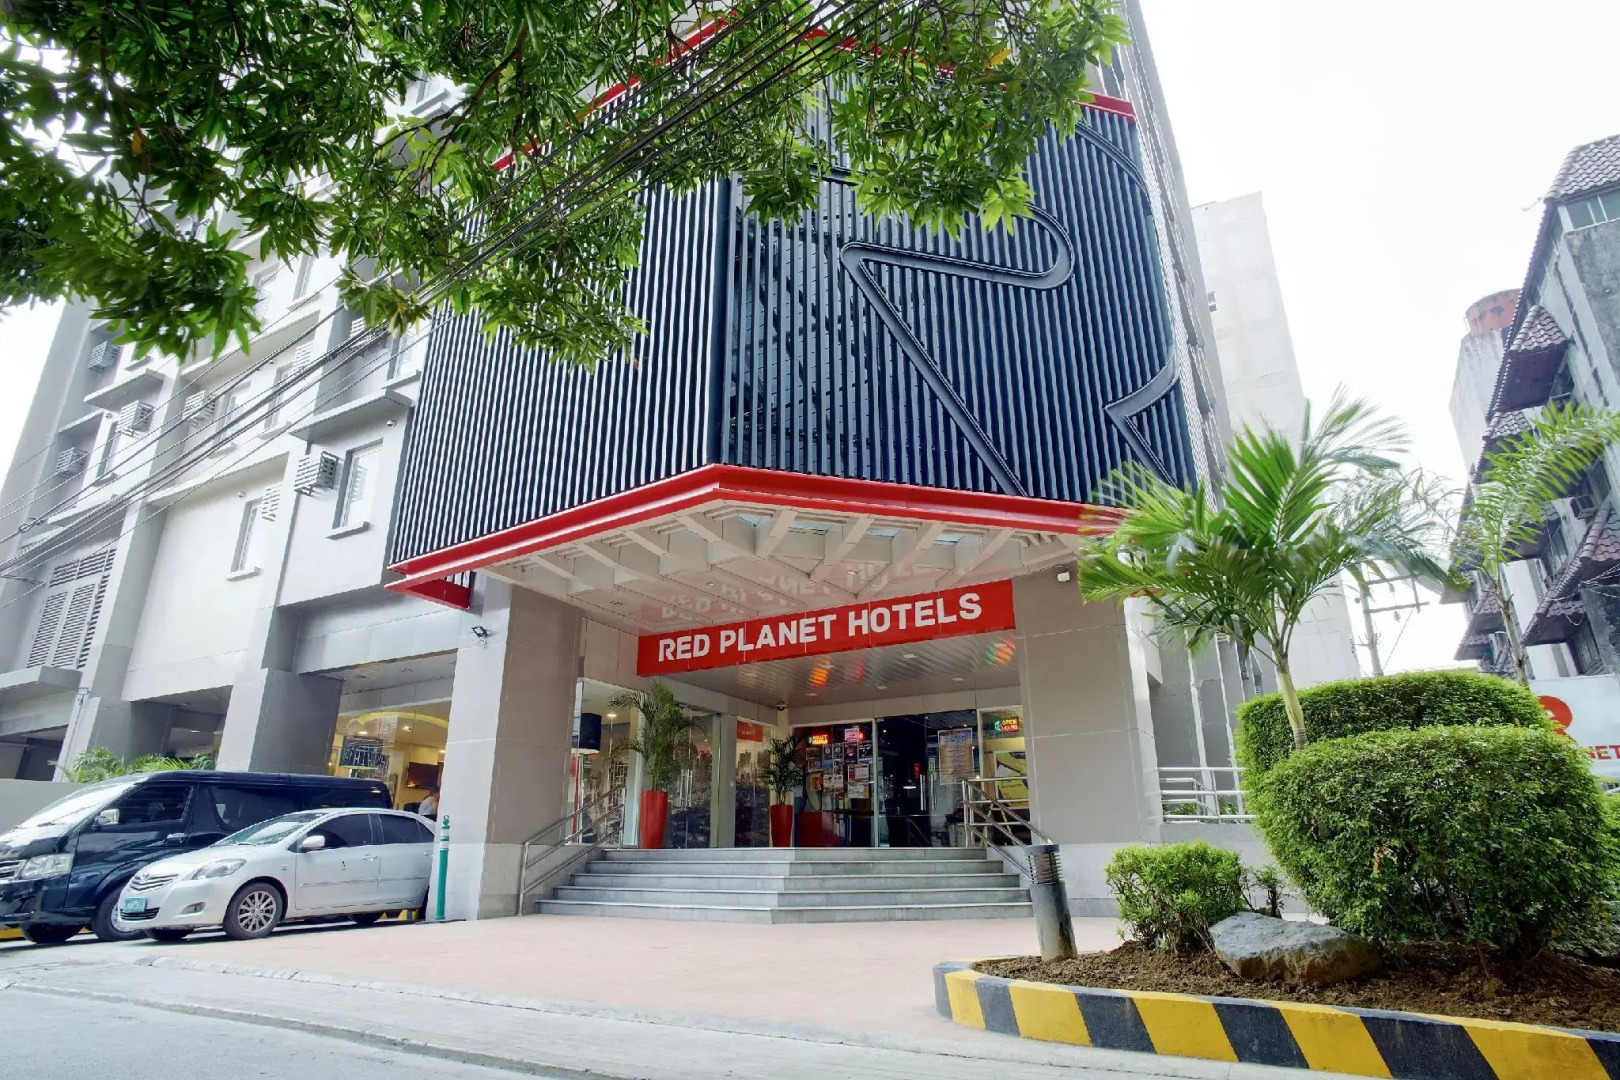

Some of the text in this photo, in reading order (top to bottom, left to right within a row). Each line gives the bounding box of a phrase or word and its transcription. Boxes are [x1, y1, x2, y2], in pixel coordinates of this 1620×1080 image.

[658, 633, 710, 662] RED
[719, 614, 837, 653] PLANET
[848, 593, 982, 637] HOTELS
